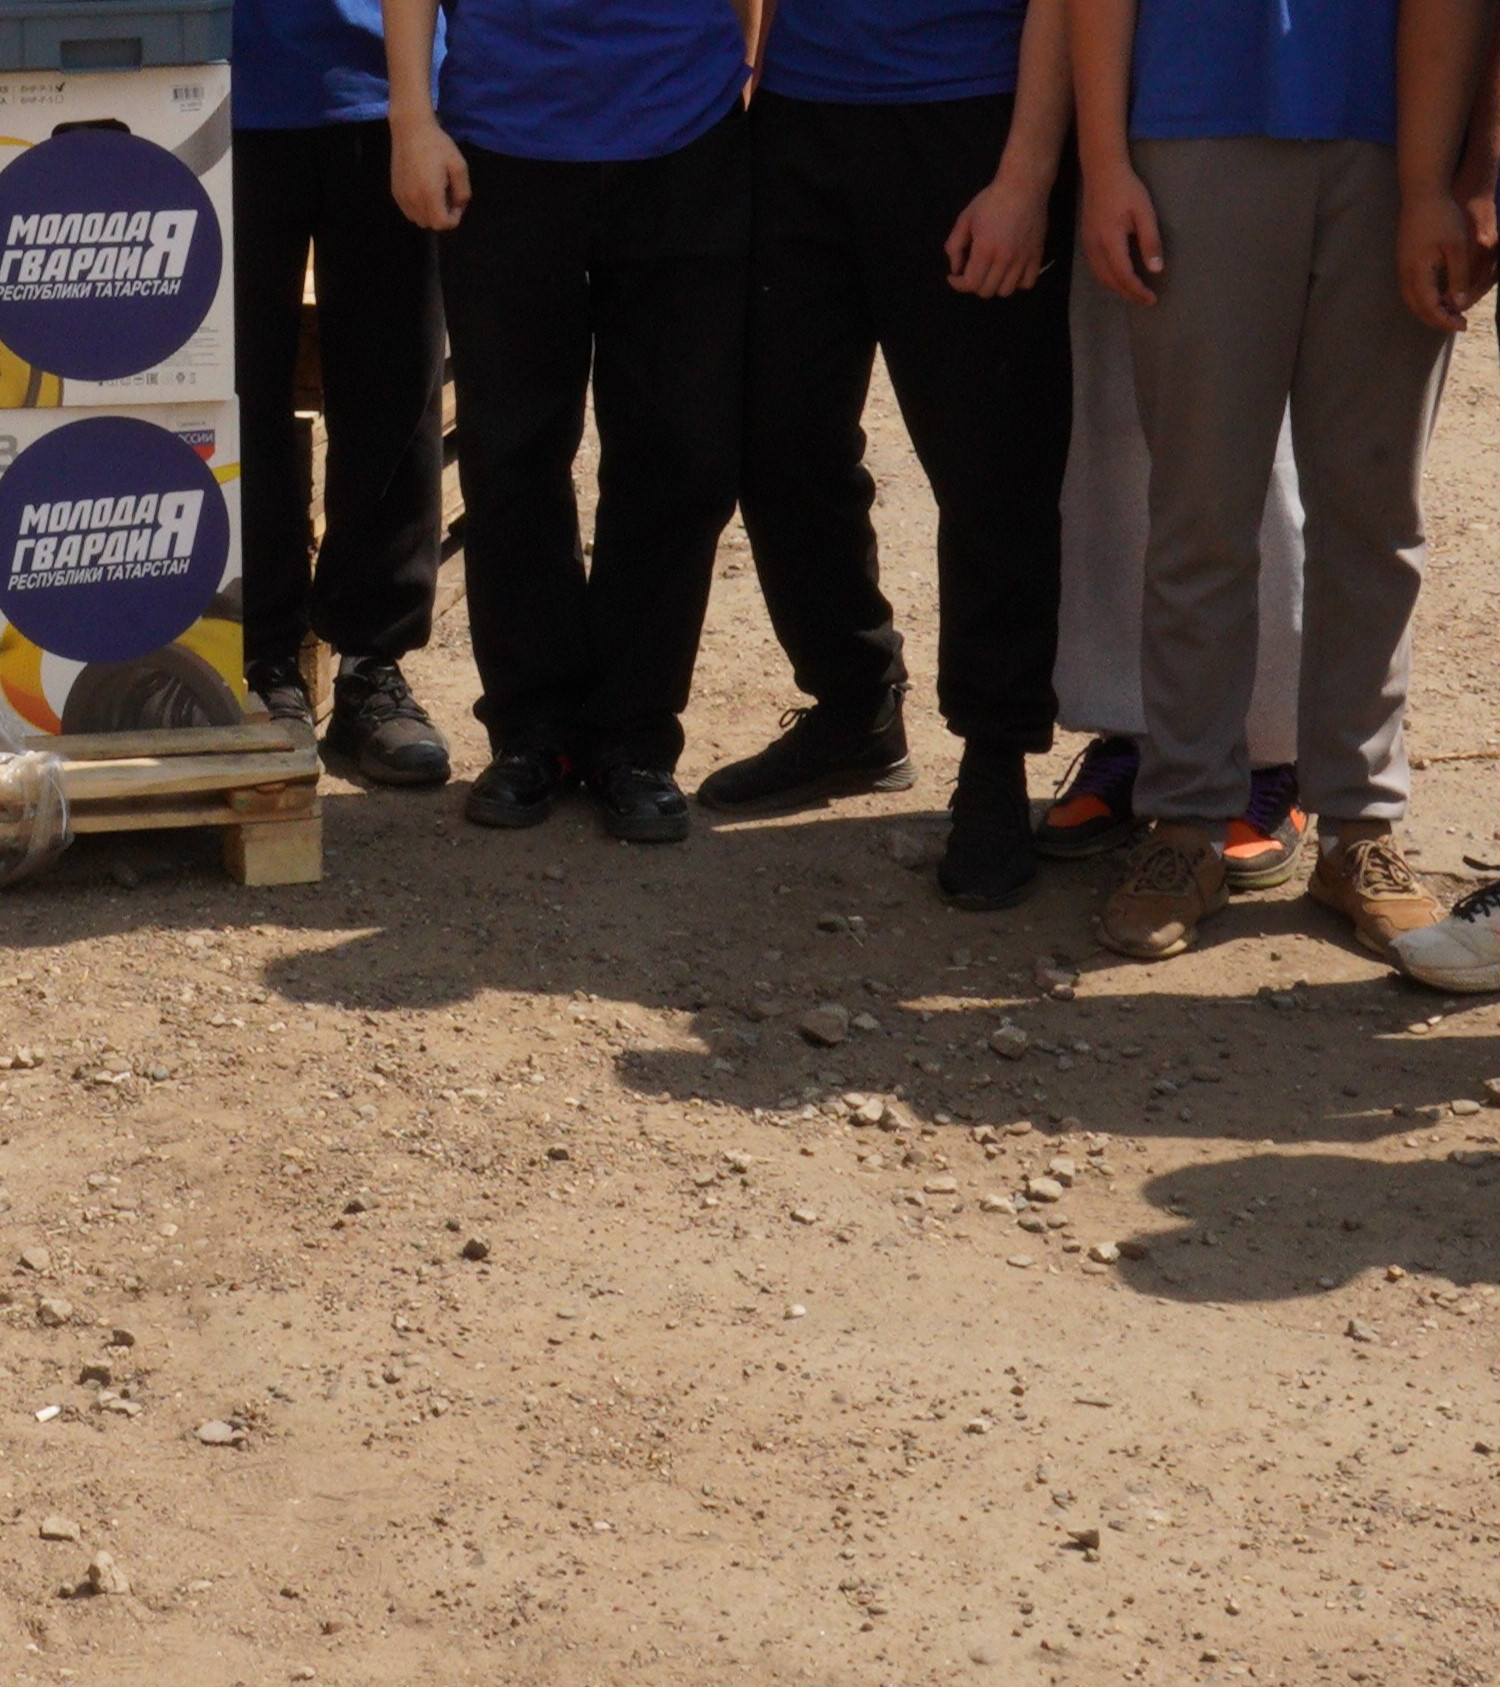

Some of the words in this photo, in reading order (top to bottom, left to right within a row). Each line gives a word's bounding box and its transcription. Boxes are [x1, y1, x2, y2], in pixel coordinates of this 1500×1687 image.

[7, 209, 198, 245] МОЛОДАЯ
[94, 279, 181, 298] ТАТАРСТАН
[19, 489, 204, 535] МОЛОДАЯ
[8, 564, 103, 591] РЕСПУБЛИКИ
[106, 558, 190, 581] ТАТАРСТАН
